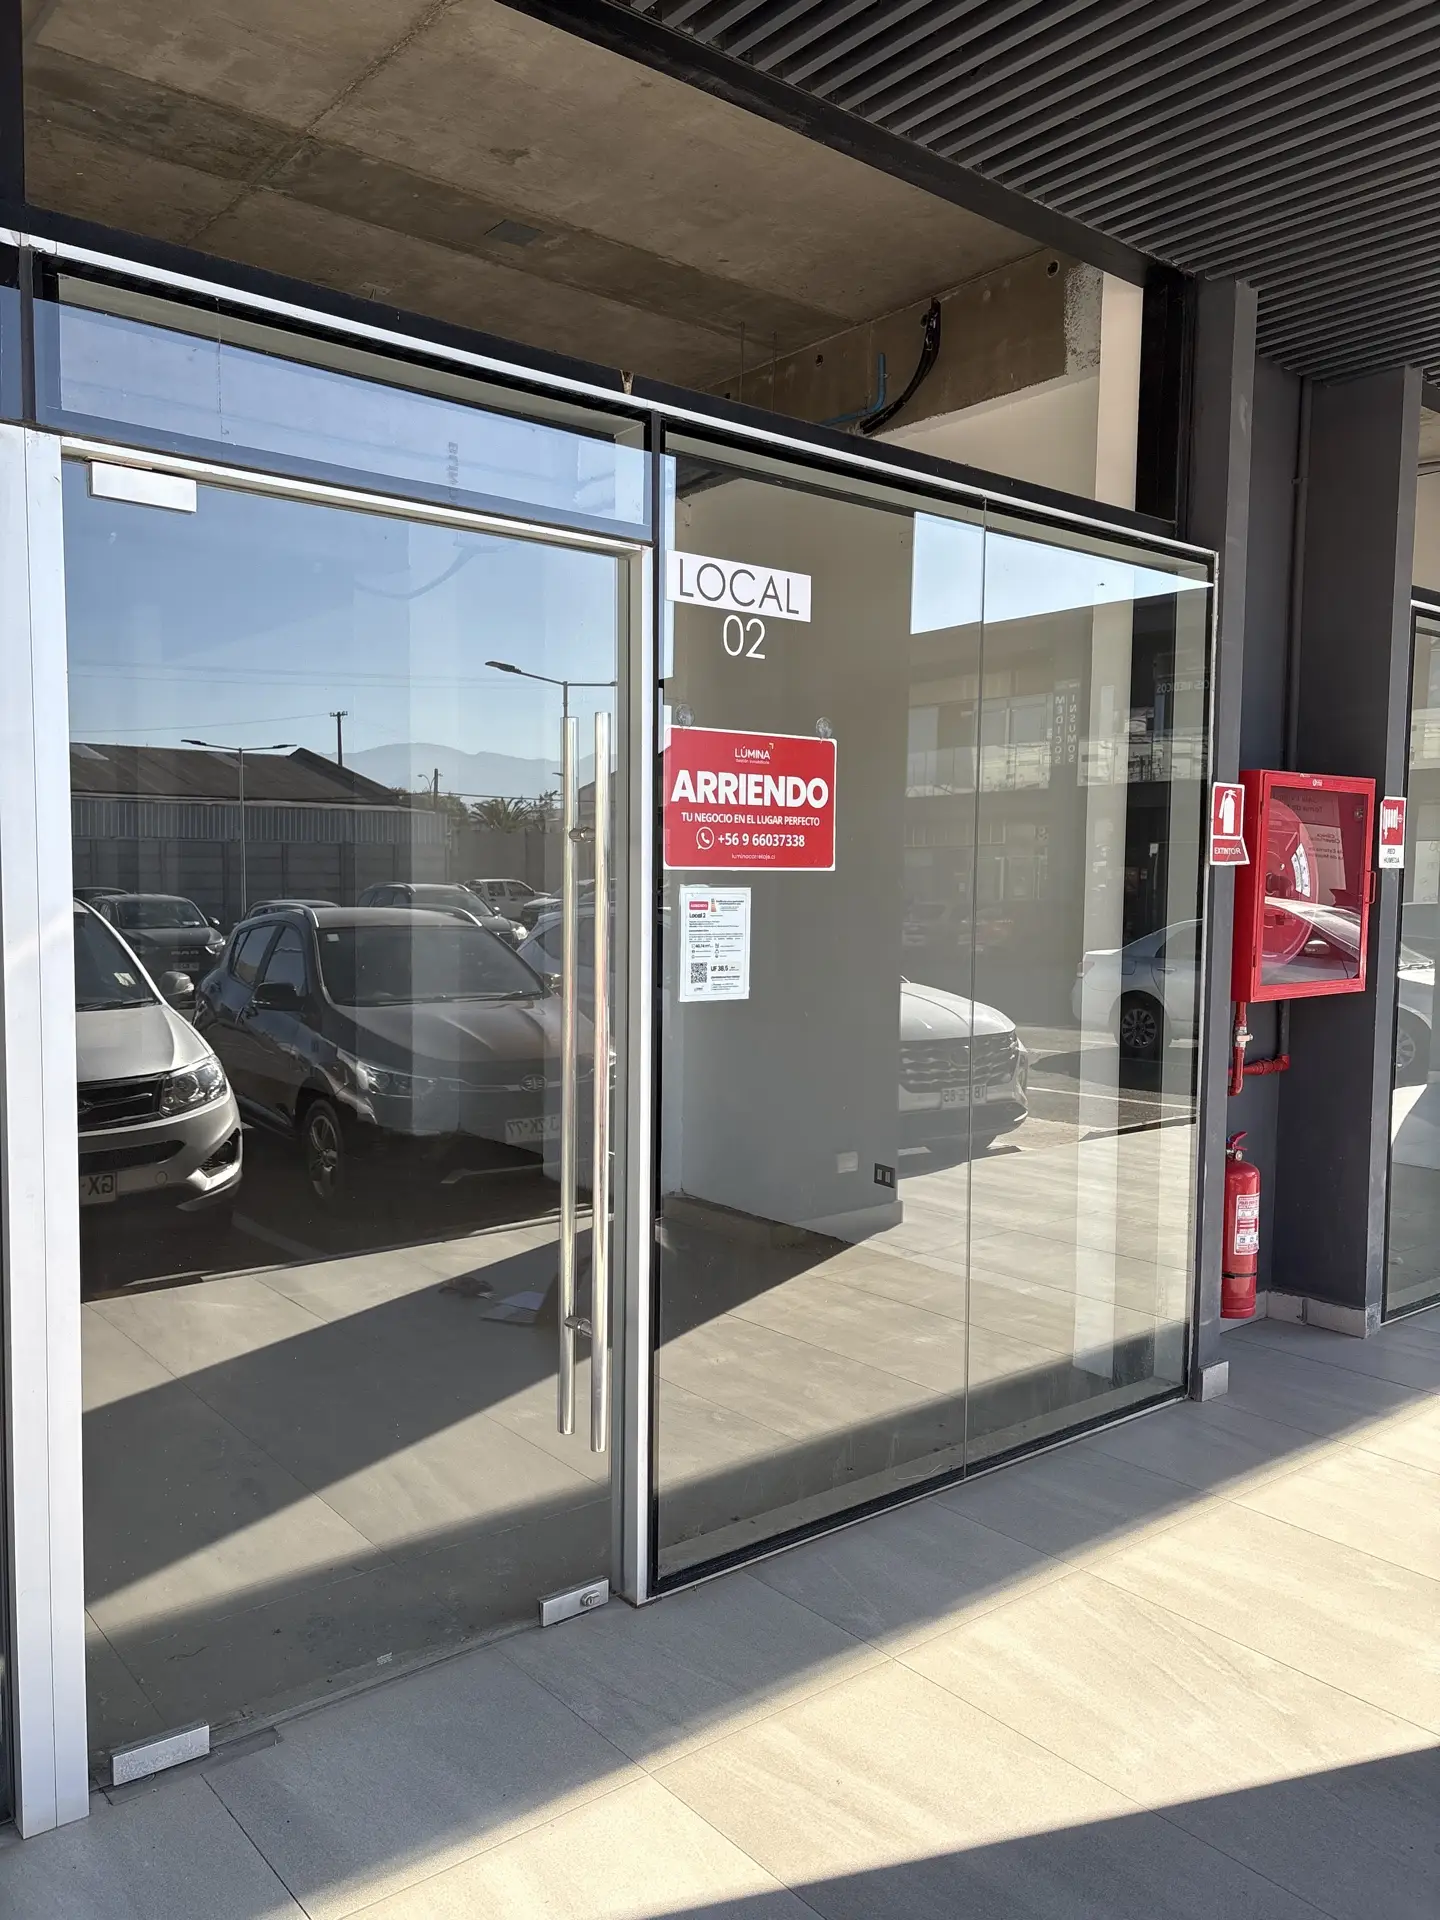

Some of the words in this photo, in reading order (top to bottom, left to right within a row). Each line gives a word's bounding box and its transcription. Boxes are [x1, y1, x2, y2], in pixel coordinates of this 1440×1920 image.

[679, 558, 799, 615] LOCAL
[723, 614, 766, 660] 02
[734, 745, 771, 760] LÚMINA
[670, 769, 829, 809] ARRIENDO
[681, 811, 693, 822] TU
[694, 812, 733, 824] NEGOCIO
[734, 813, 745, 824] EN
[746, 814, 756, 825] EL
[756, 814, 783, 825] LUGAR
[784, 815, 820, 827] PERFECTO
[718, 832, 739, 846] +56
[741, 832, 750, 847] 9
[751, 833, 805, 848] 66037338
[1214, 847, 1242, 855] EXTINTOR
